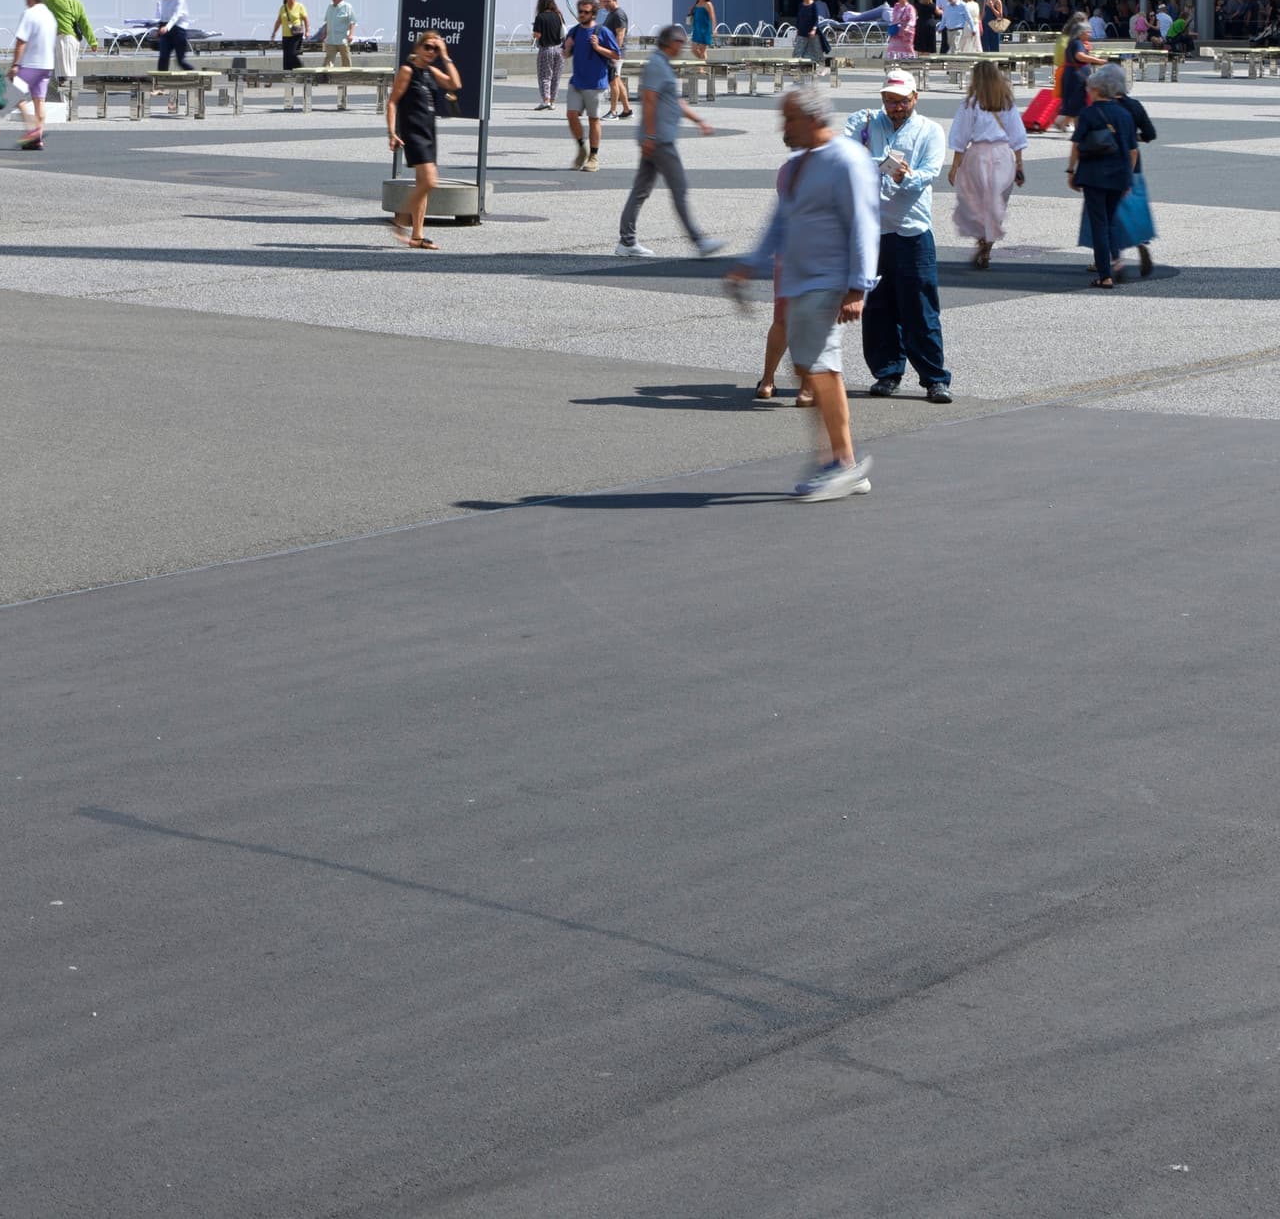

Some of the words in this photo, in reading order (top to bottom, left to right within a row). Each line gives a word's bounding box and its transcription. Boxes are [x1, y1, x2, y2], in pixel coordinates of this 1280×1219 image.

[408, 17, 429, 28] Taxi
[431, 18, 464, 32] Pickup
[408, 31, 415, 42] &
